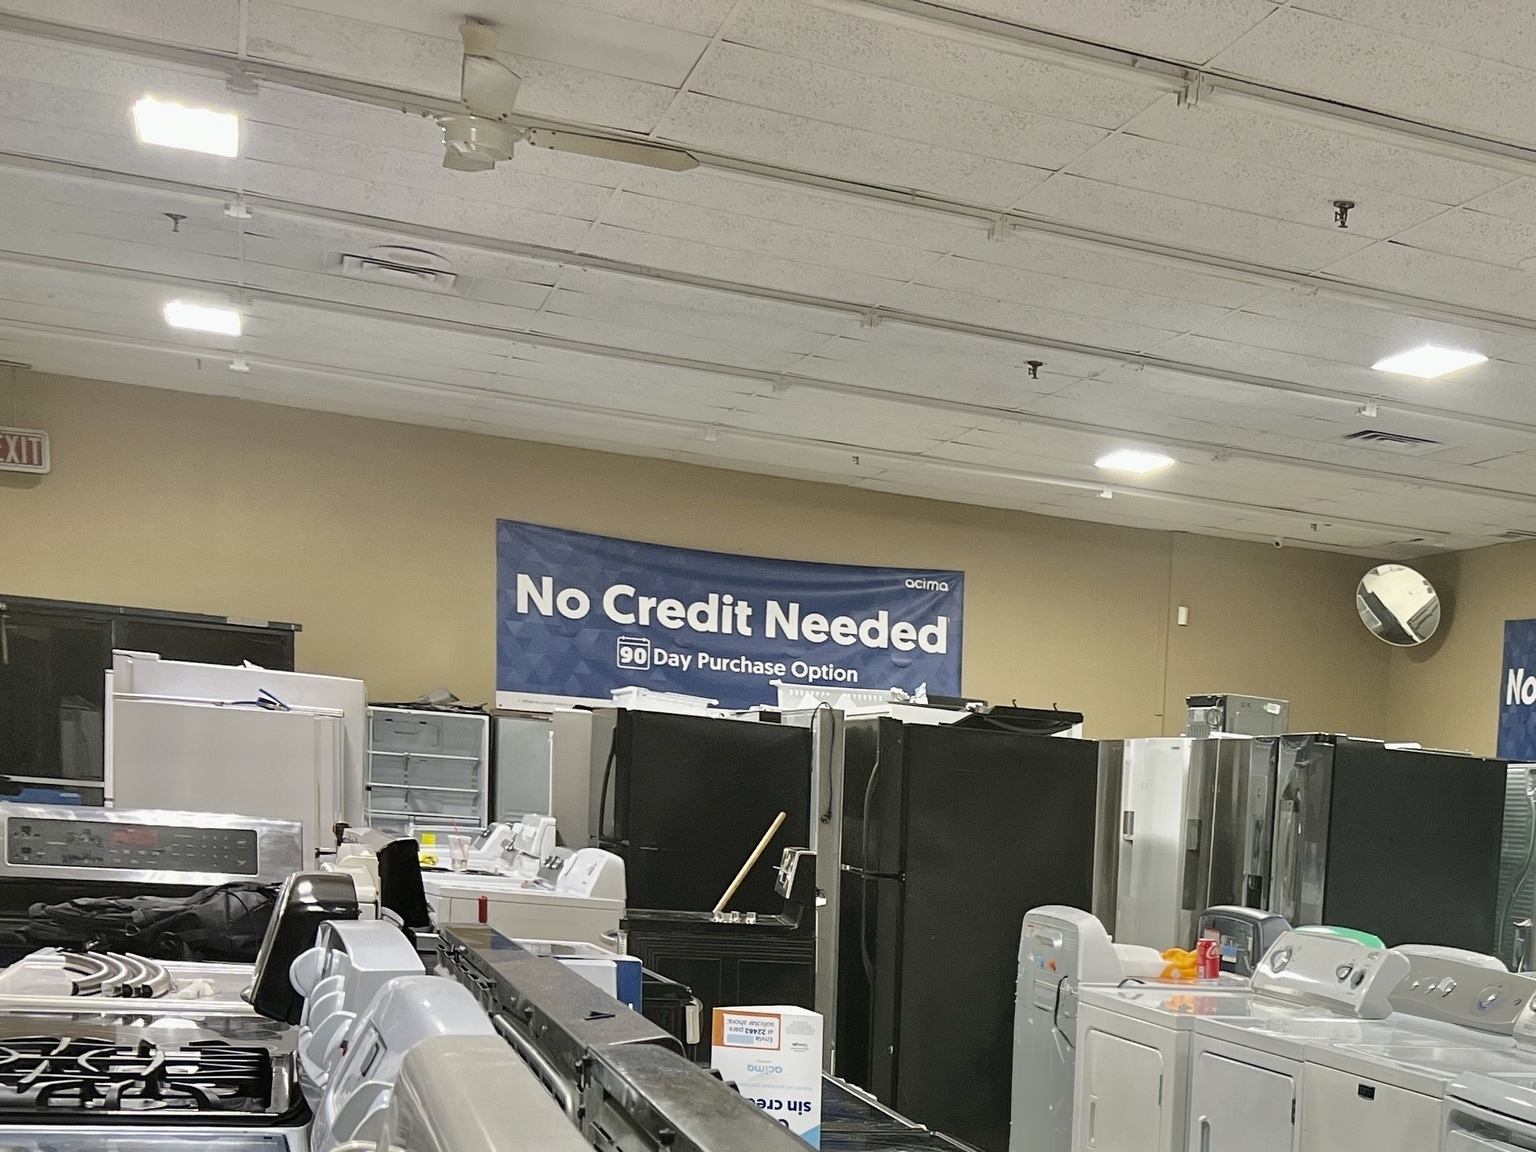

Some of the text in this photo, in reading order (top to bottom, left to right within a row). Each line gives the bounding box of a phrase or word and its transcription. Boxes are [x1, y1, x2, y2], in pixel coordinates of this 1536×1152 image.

[0, 434, 41, 465] XIT
[904, 577, 950, 592] acima
[516, 573, 948, 655] No Credit Needed
[620, 646, 859, 683] 90 Day Purchase Option
[747, 1064, 783, 1075] acima
[787, 1100, 812, 1115] sin
